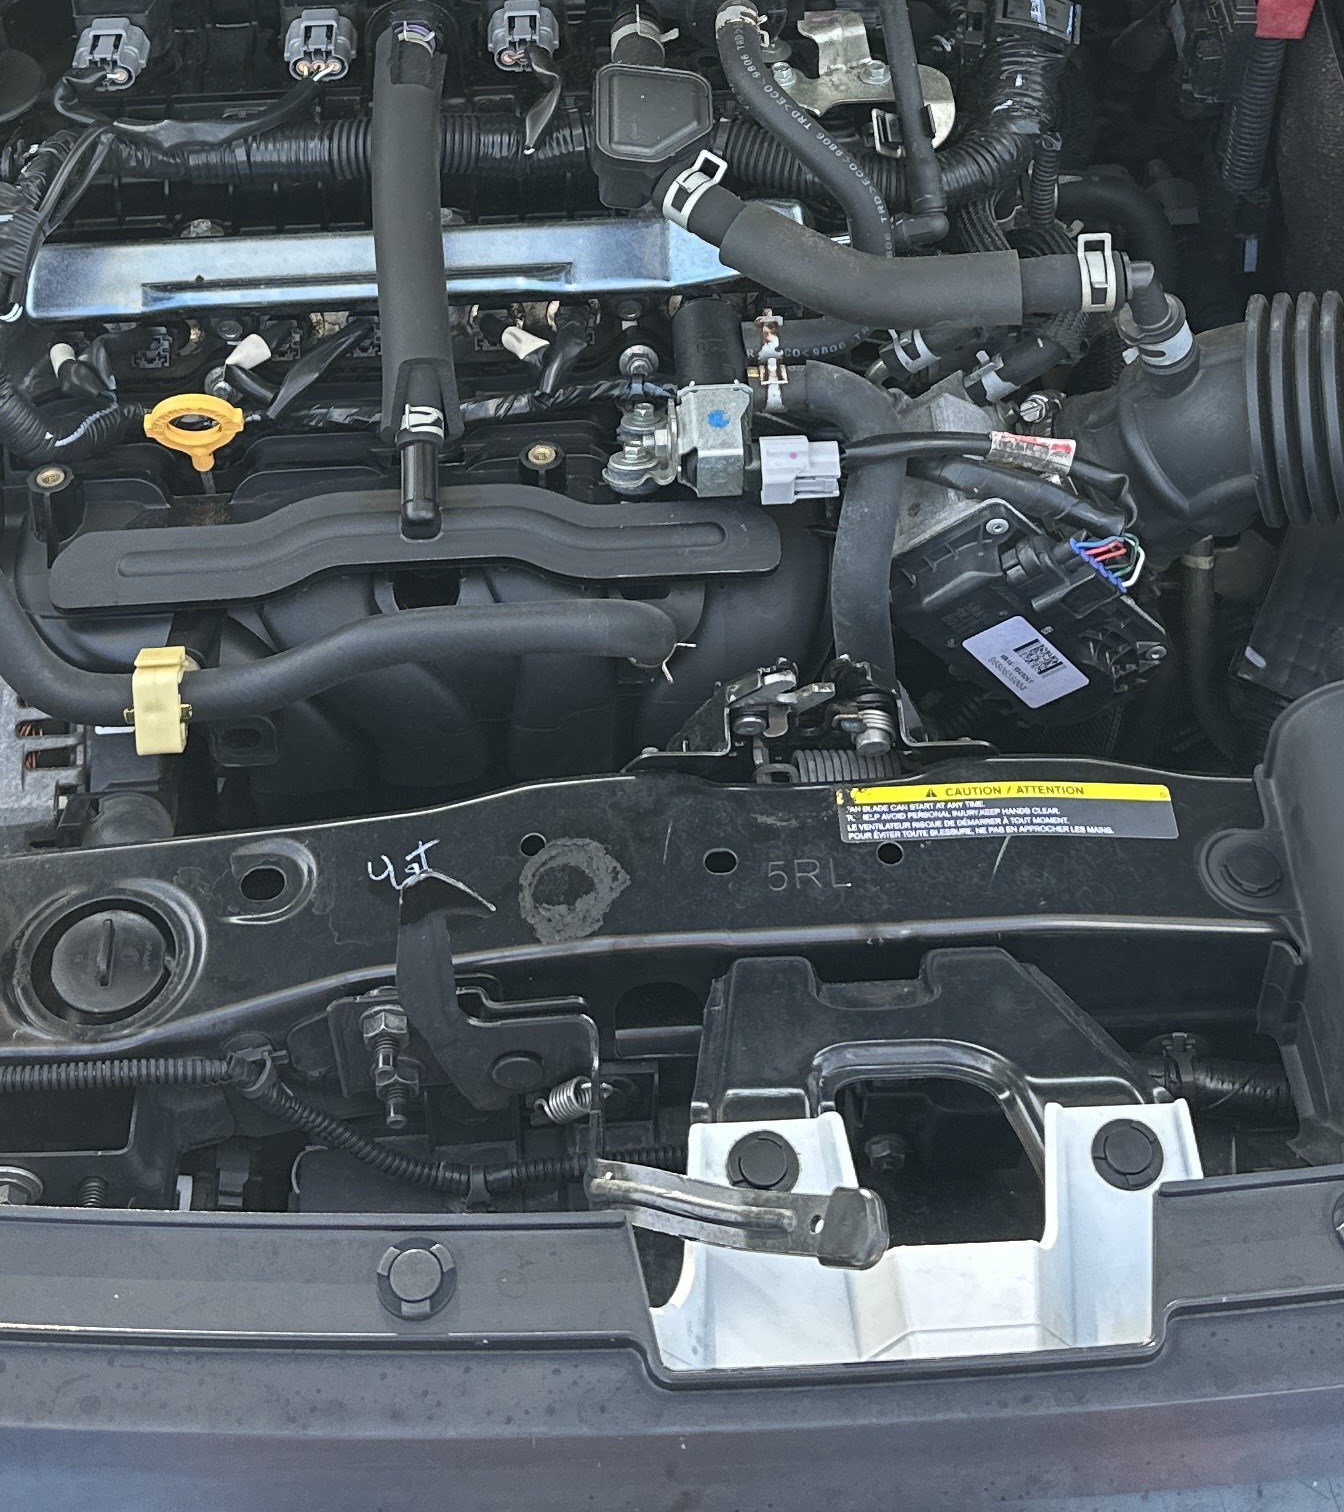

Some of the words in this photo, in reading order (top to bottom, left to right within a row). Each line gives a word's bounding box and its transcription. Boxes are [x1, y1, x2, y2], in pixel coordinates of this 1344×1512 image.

[945, 786, 1002, 797] CAUTION
[1016, 785, 1085, 795] ATTENTION
[862, 804, 889, 813] BLADE
[890, 804, 908, 812] CAN
[910, 803, 934, 811] START
[881, 812, 907, 820] AVOID
[907, 811, 951, 819] PERSONAL
[1002, 807, 1031, 815] HANDS
[1032, 807, 1061, 815] CLEAR.
[859, 822, 911, 831] VENTILATEUR
[912, 820, 943, 829] RISQUE
[957, 817, 1002, 826] DÉMARRER
[1010, 816, 1031, 824] TOUT
[847, 831, 872, 839] POUR
[873, 830, 901, 838] ÉVITER
[902, 829, 929, 837] TOUTE
[930, 828, 974, 837] BLESSURE,
[988, 826, 1005, 834] PAS
[1019, 825, 1070, 833] APPROCHER
[1070, 825, 1086, 834] LES
[1086, 826, 1115, 834] MAINS.
[767, 859, 852, 890] 5RL
